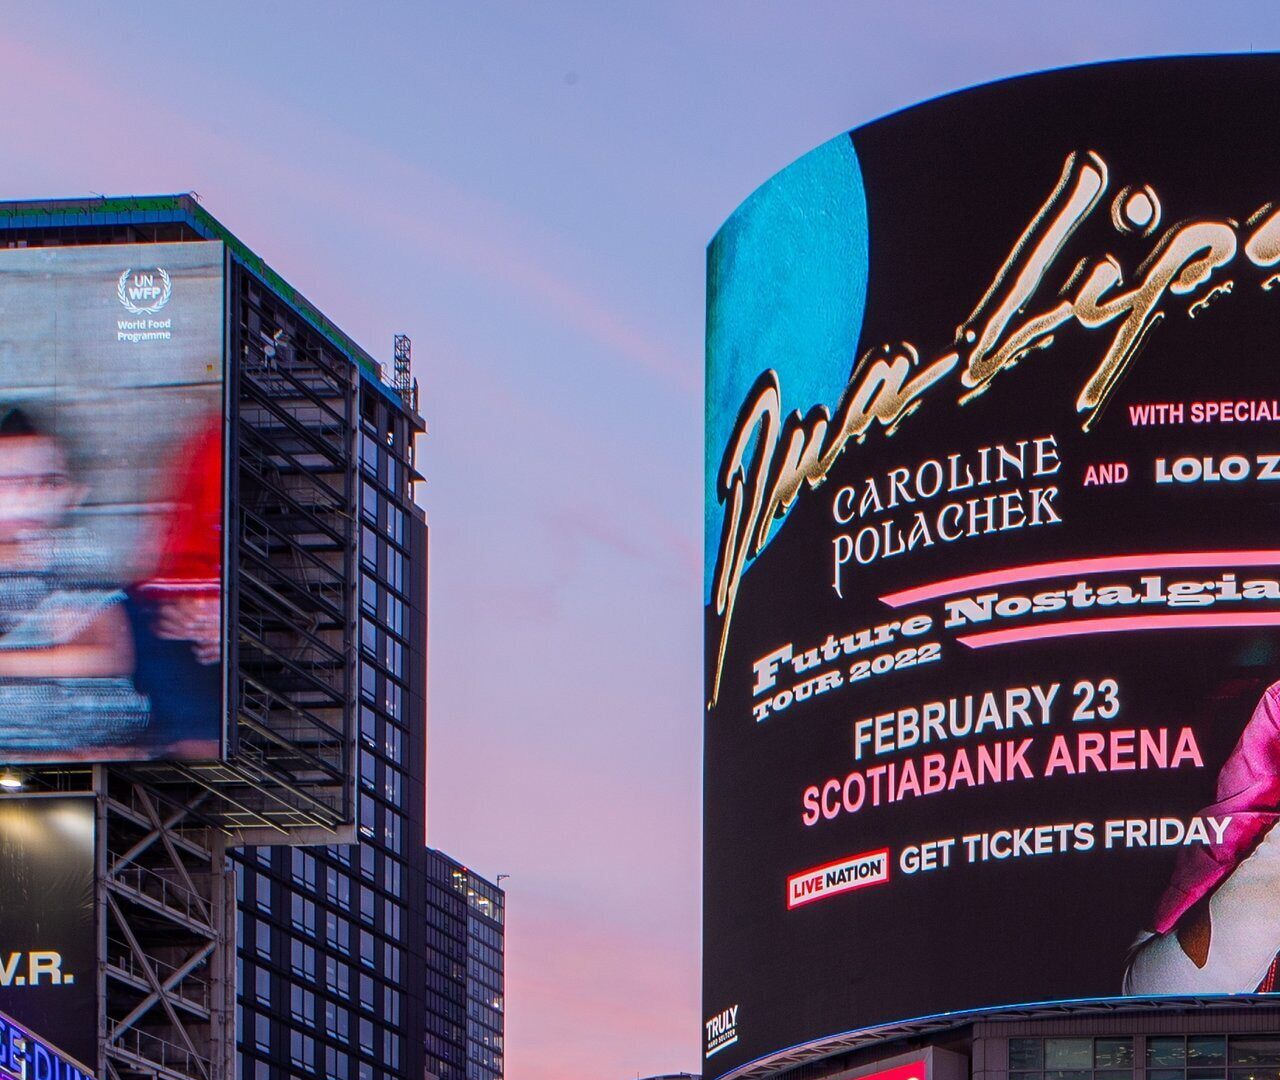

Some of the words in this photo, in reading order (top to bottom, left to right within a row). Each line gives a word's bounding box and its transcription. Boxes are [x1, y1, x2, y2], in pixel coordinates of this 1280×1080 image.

[128, 287, 160, 300] WFP
[134, 274, 153, 288] UN
[117, 320, 146, 330] World
[148, 318, 171, 329] Food
[117, 331, 171, 344] Programme
[1128, 402, 1185, 427] WITH
[831, 434, 1062, 526] CAROLINE
[1083, 462, 1130, 488] AND
[1155, 455, 1250, 484] LOLO
[831, 486, 1063, 600] POLACHEK
[751, 607, 934, 697] Future
[751, 669, 845, 723] TOUR
[849, 641, 942, 683] 2022
[853, 682, 1061, 761] FEBRUARY
[1073, 678, 1121, 722] 23
[801, 737, 1034, 827] SCOTIABANK
[1044, 725, 1205, 777] ARENA
[899, 837, 956, 877] GET
[962, 821, 1095, 860] TICKETS
[1104, 815, 1234, 849] FRIDAY
[793, 871, 824, 902] LIVE
[825, 859, 885, 890] NATION
[705, 1004, 738, 1041] TRULY
